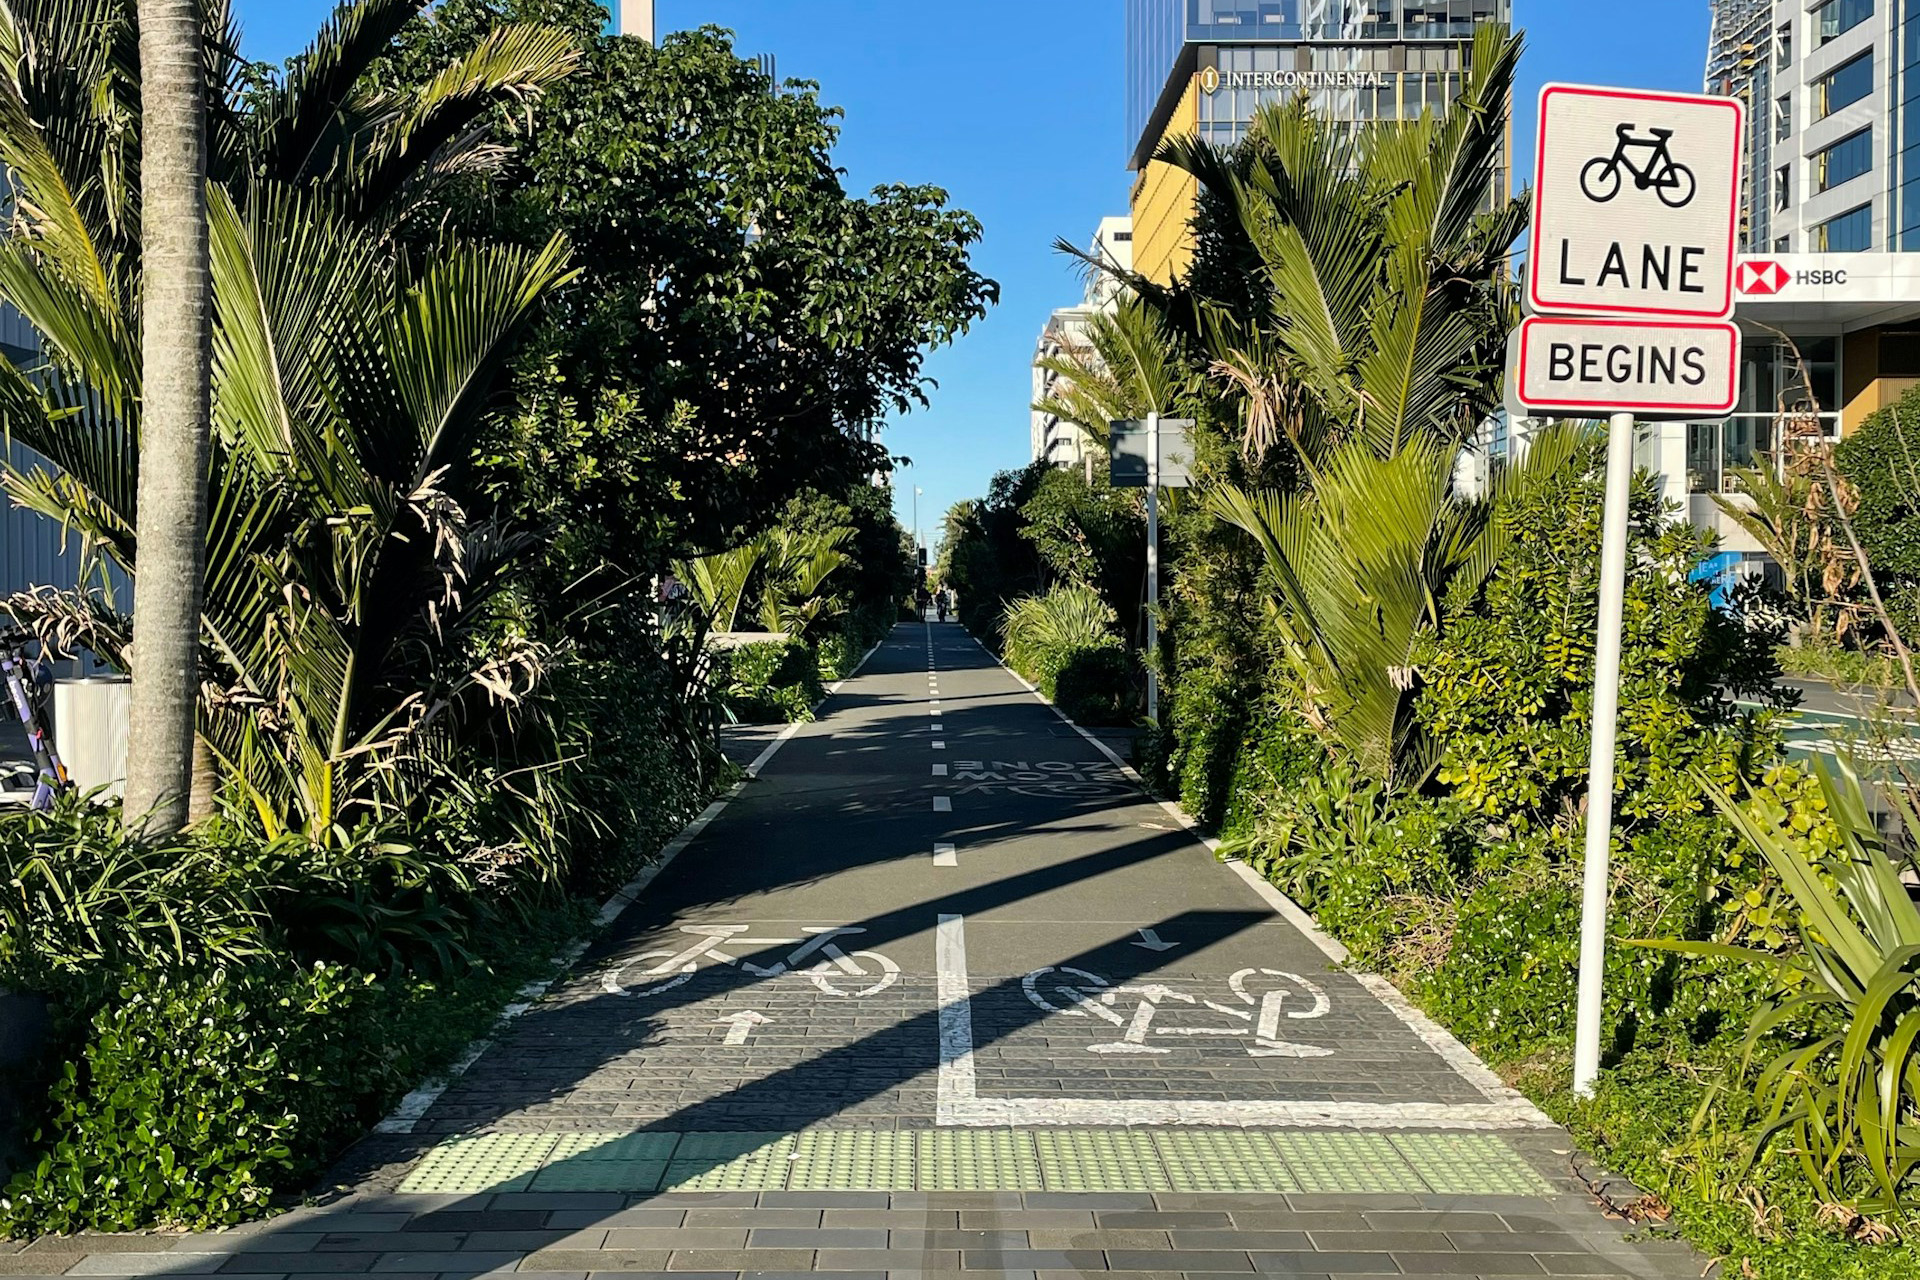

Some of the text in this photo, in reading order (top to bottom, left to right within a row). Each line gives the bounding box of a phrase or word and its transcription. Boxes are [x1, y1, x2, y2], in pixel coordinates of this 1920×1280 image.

[1559, 238, 1705, 293] LANE
[1796, 270, 1847, 285] HSBC
[1550, 342, 1706, 386] BEGINS
[953, 761, 1121, 772] ZONE
[952, 771, 1127, 781] SLOW
